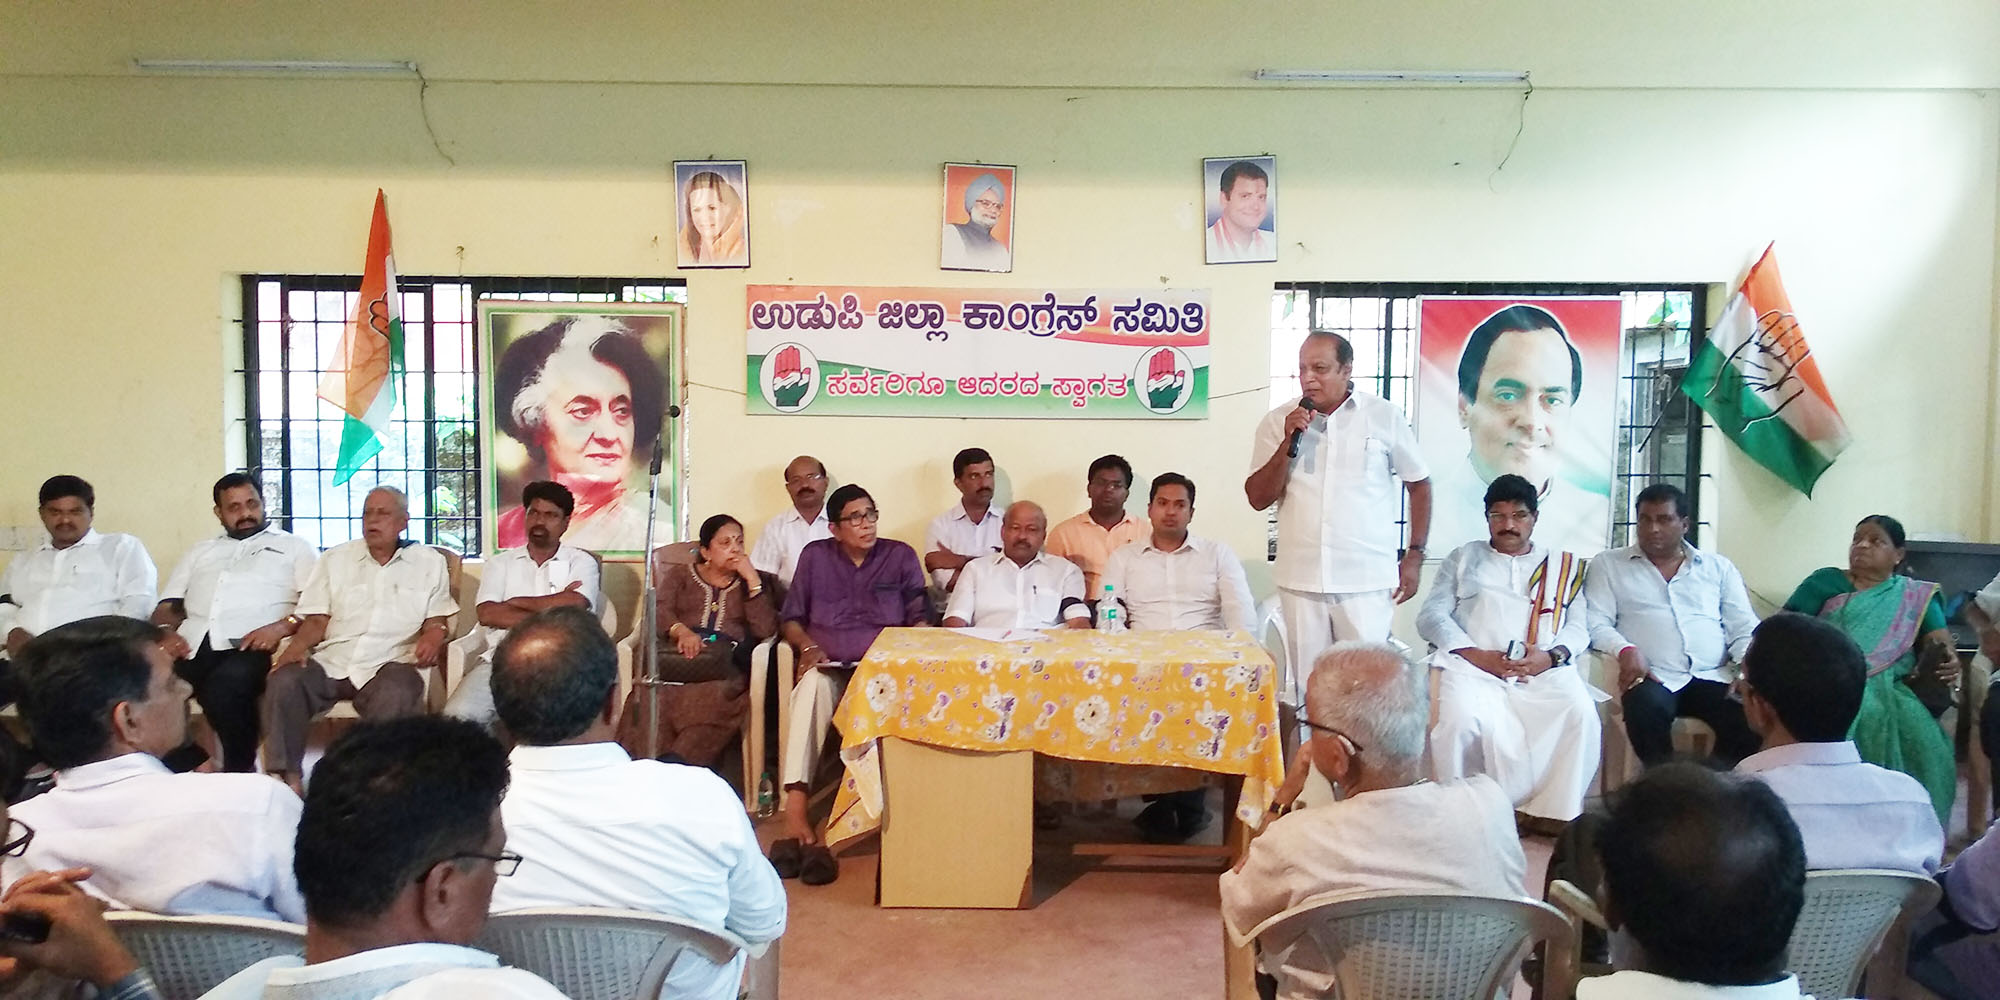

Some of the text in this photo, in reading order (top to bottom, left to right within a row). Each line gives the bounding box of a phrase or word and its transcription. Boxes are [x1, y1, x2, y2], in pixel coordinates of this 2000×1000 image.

[752, 293, 1204, 342] ಉಡುಪಿ ಜಿಲ್ಲಾ ಕಾಂಗ್ರೆಸ್ ಸಮಿತಿ
[827, 370, 1127, 408] ಸರ್ವರಿಗೂ ಆದರದ ಸ್ವಾಗತ
